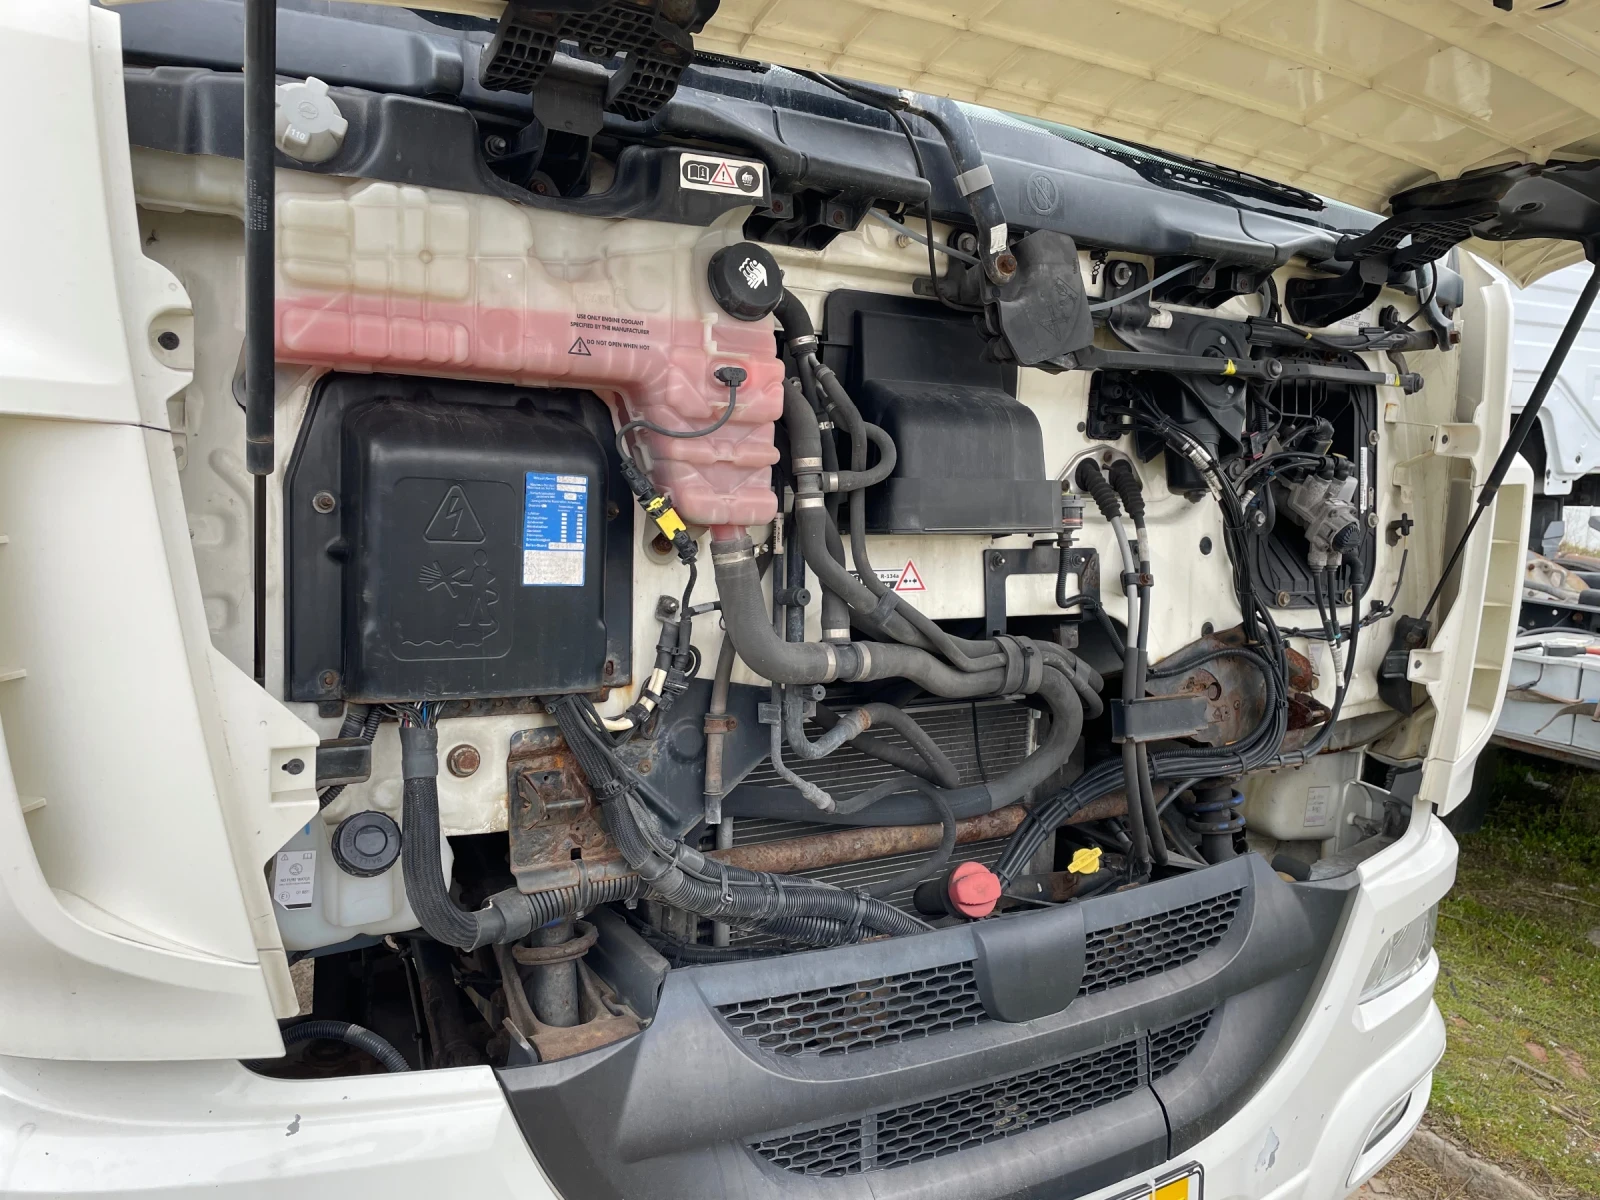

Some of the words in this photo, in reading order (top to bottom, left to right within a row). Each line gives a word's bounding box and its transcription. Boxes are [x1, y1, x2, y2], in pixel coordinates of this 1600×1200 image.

[291, 128, 306, 140] 110
[601, 316, 620, 324] ENGINE
[620, 318, 644, 326] COOLANT
[570, 321, 594, 329] SPECIFIED
[612, 326, 650, 335] MANUFACTURER
[623, 342, 638, 350] WHEN
